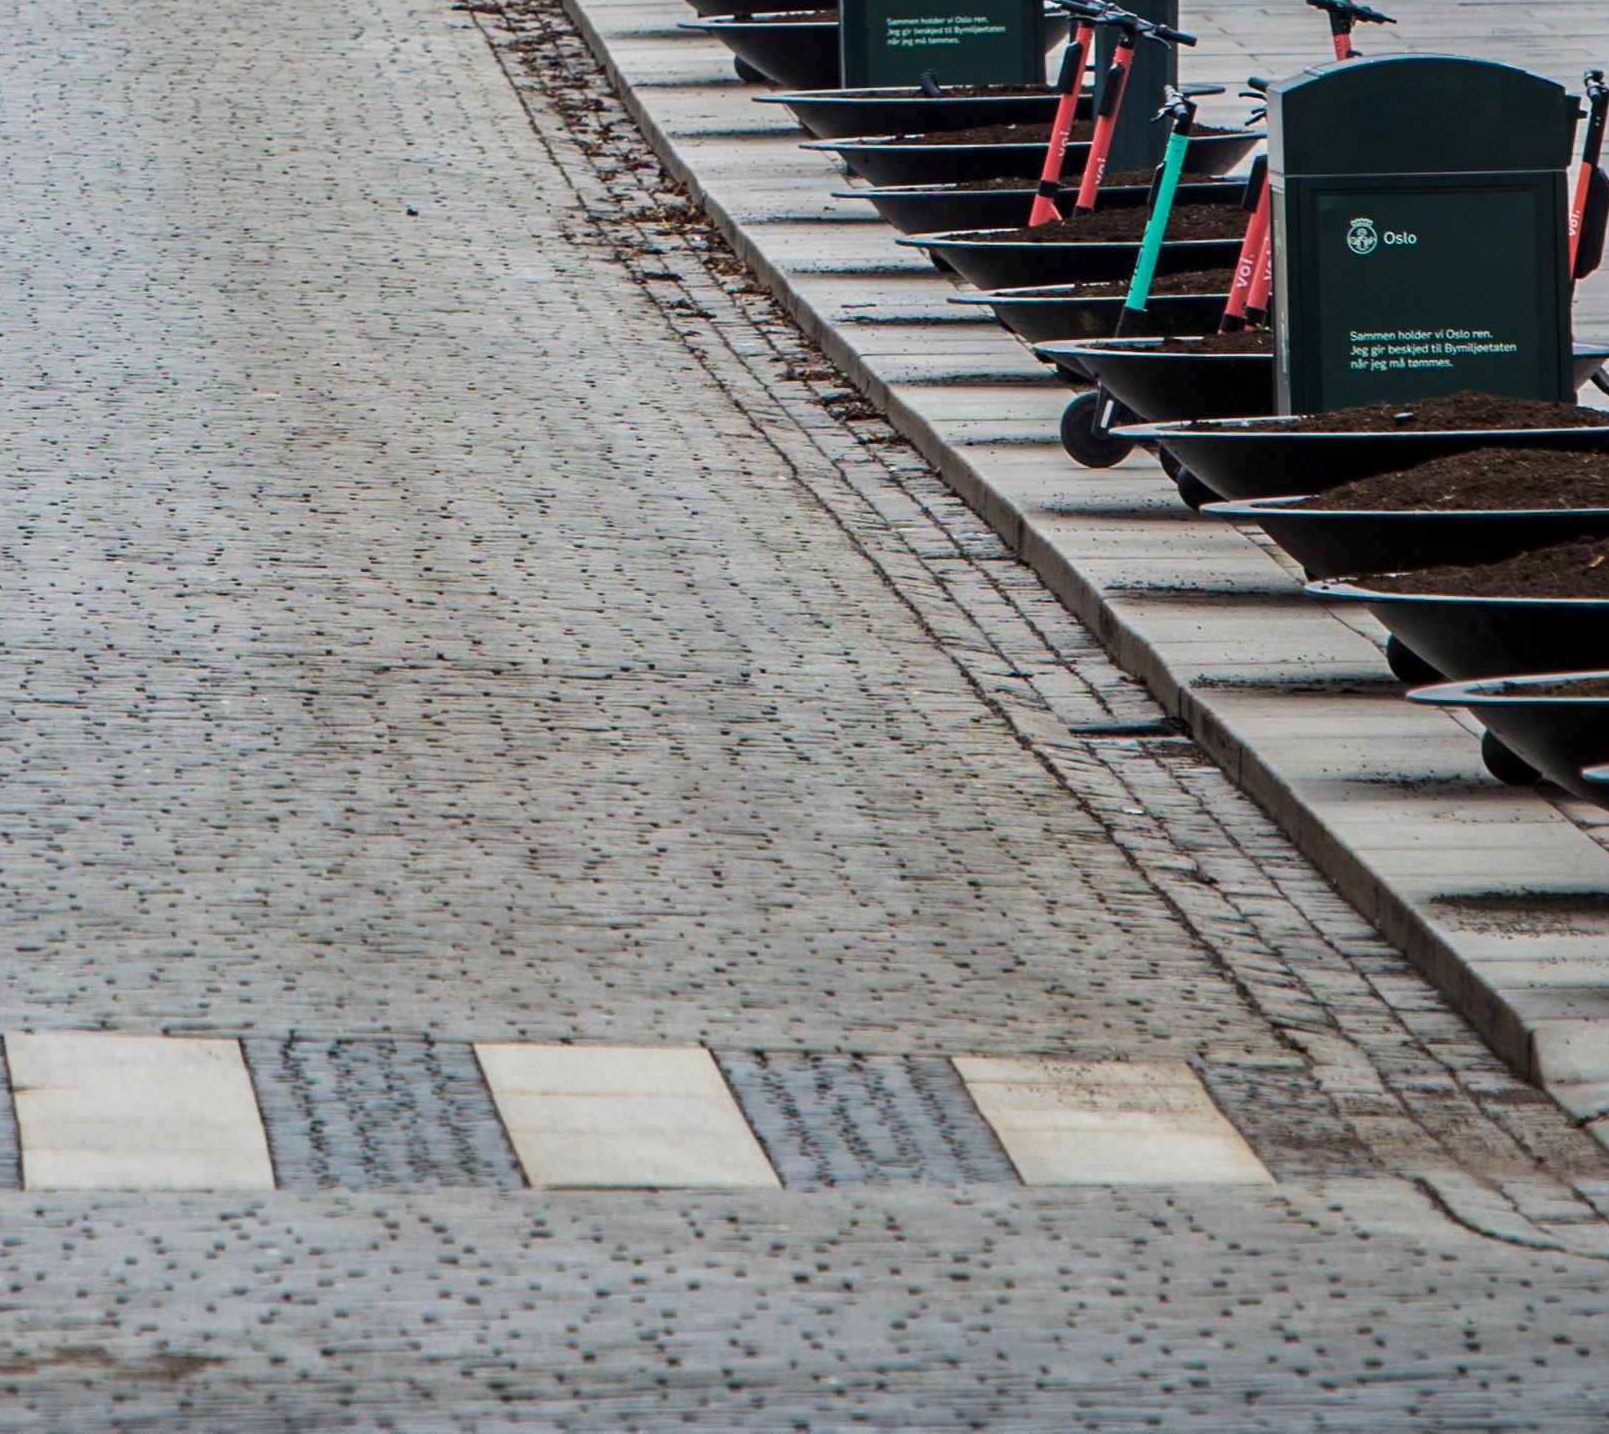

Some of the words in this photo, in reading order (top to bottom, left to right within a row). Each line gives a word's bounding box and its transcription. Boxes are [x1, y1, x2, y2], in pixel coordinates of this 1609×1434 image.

[886, 18, 919, 26] Sammen
[920, 17, 945, 25] holder
[955, 16, 973, 24] Oslo
[1383, 231, 1417, 245] Oslo
[1350, 331, 1396, 342] Sammen
[1398, 330, 1432, 341] holder
[1435, 330, 1444, 340] vi
[1446, 329, 1470, 340] Oslo
[1473, 330, 1494, 339] ren.
[1350, 345, 1369, 358] Jeg
[1370, 345, 1387, 357] gir
[1388, 344, 1429, 356] beskjed
[1431, 343, 1442, 354] til
[1444, 343, 1518, 356] Bymiljøetaten
[1350, 359, 1368, 369] når
[1370, 359, 1388, 372] jeg
[1389, 357, 1406, 369] må
[1408, 357, 1454, 368] tømmes.
